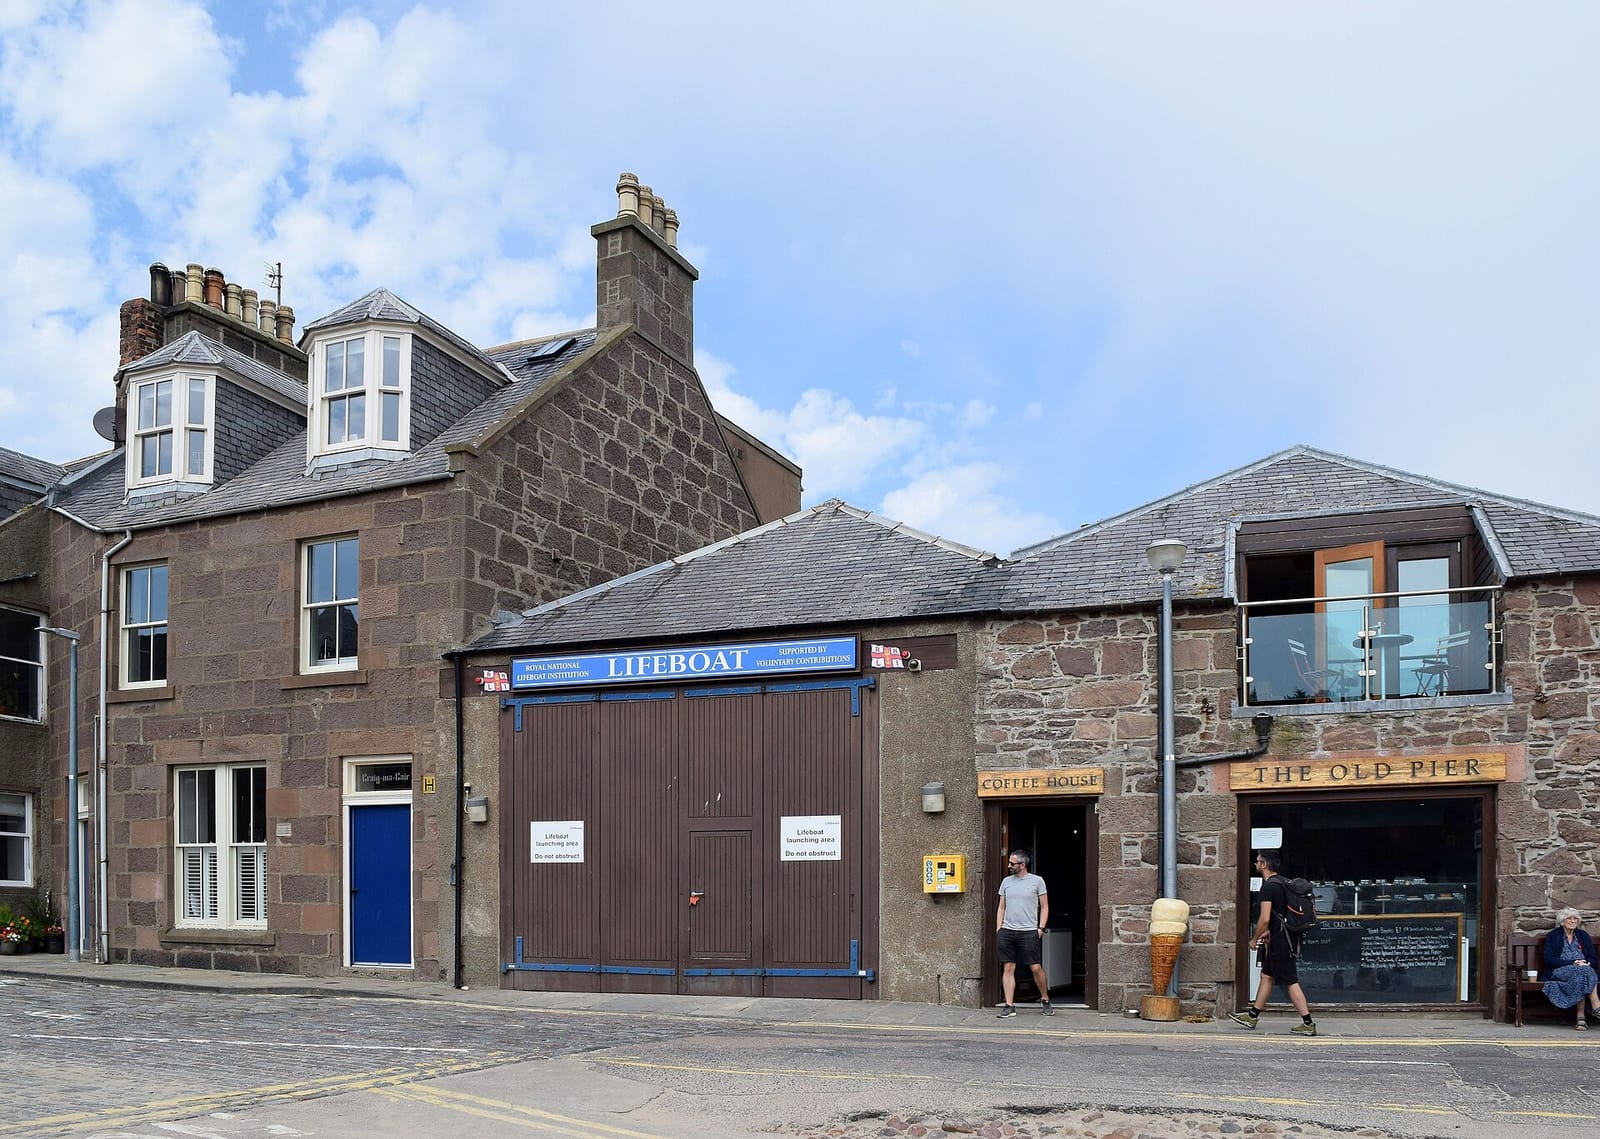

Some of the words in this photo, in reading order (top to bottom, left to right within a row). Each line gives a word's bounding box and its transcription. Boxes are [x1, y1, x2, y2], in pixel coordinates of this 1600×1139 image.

[778, 646, 817, 655] SUPPORTED
[818, 645, 827, 653] BY
[525, 664, 546, 672] ROYAL
[547, 661, 580, 670] NATIONAL
[607, 649, 749, 677] LIFEBOAT
[756, 657, 795, 667] VOLUNTARY
[795, 654, 851, 665] CONTRIBUTIONS
[517, 673, 547, 681] LIFEBOAT
[547, 670, 590, 680] INSTITUTION
[1254, 765, 1312, 783] THE
[1329, 762, 1392, 781] OLD
[1410, 758, 1481, 778] PIER
[982, 777, 1039, 790] COFFEE
[1047, 775, 1098, 787] HOUSE
